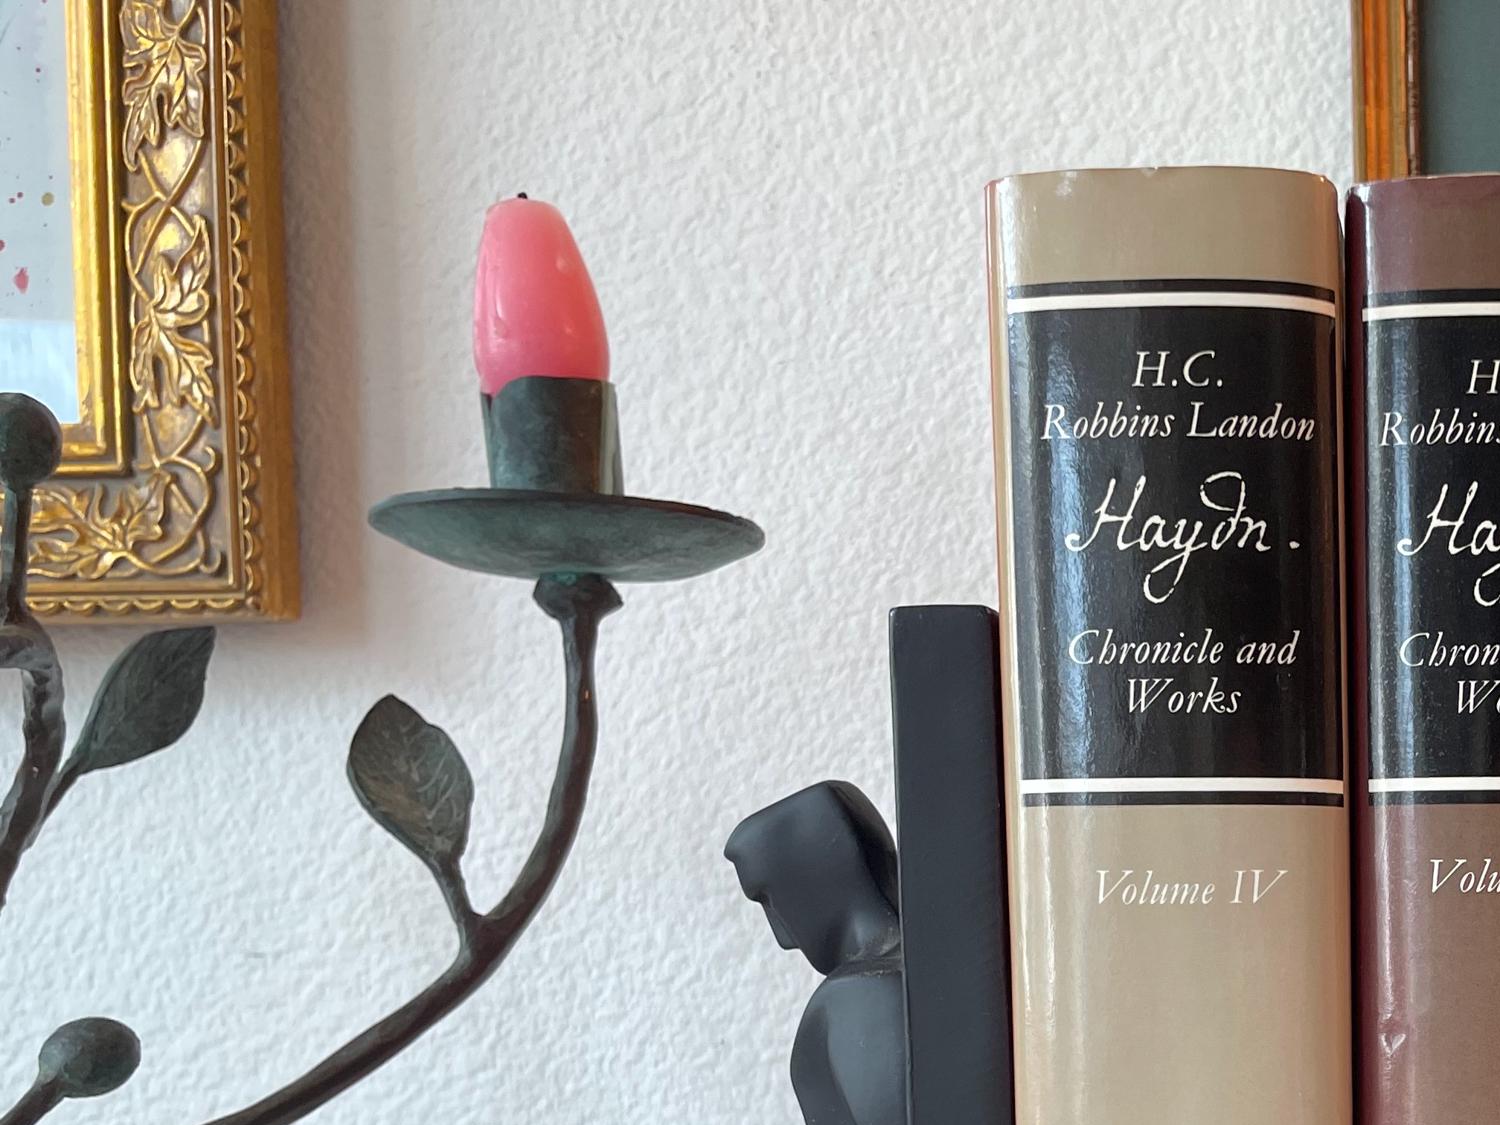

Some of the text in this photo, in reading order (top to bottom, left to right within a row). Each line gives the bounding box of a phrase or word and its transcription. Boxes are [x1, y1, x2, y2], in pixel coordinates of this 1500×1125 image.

[1132, 349, 1223, 388] H.C.
[1041, 401, 1316, 441] Robbins Landon
[1068, 629, 1298, 666] Chronicle and
[1127, 678, 1242, 714] Works
[1096, 869, 1288, 905] Volume IV
